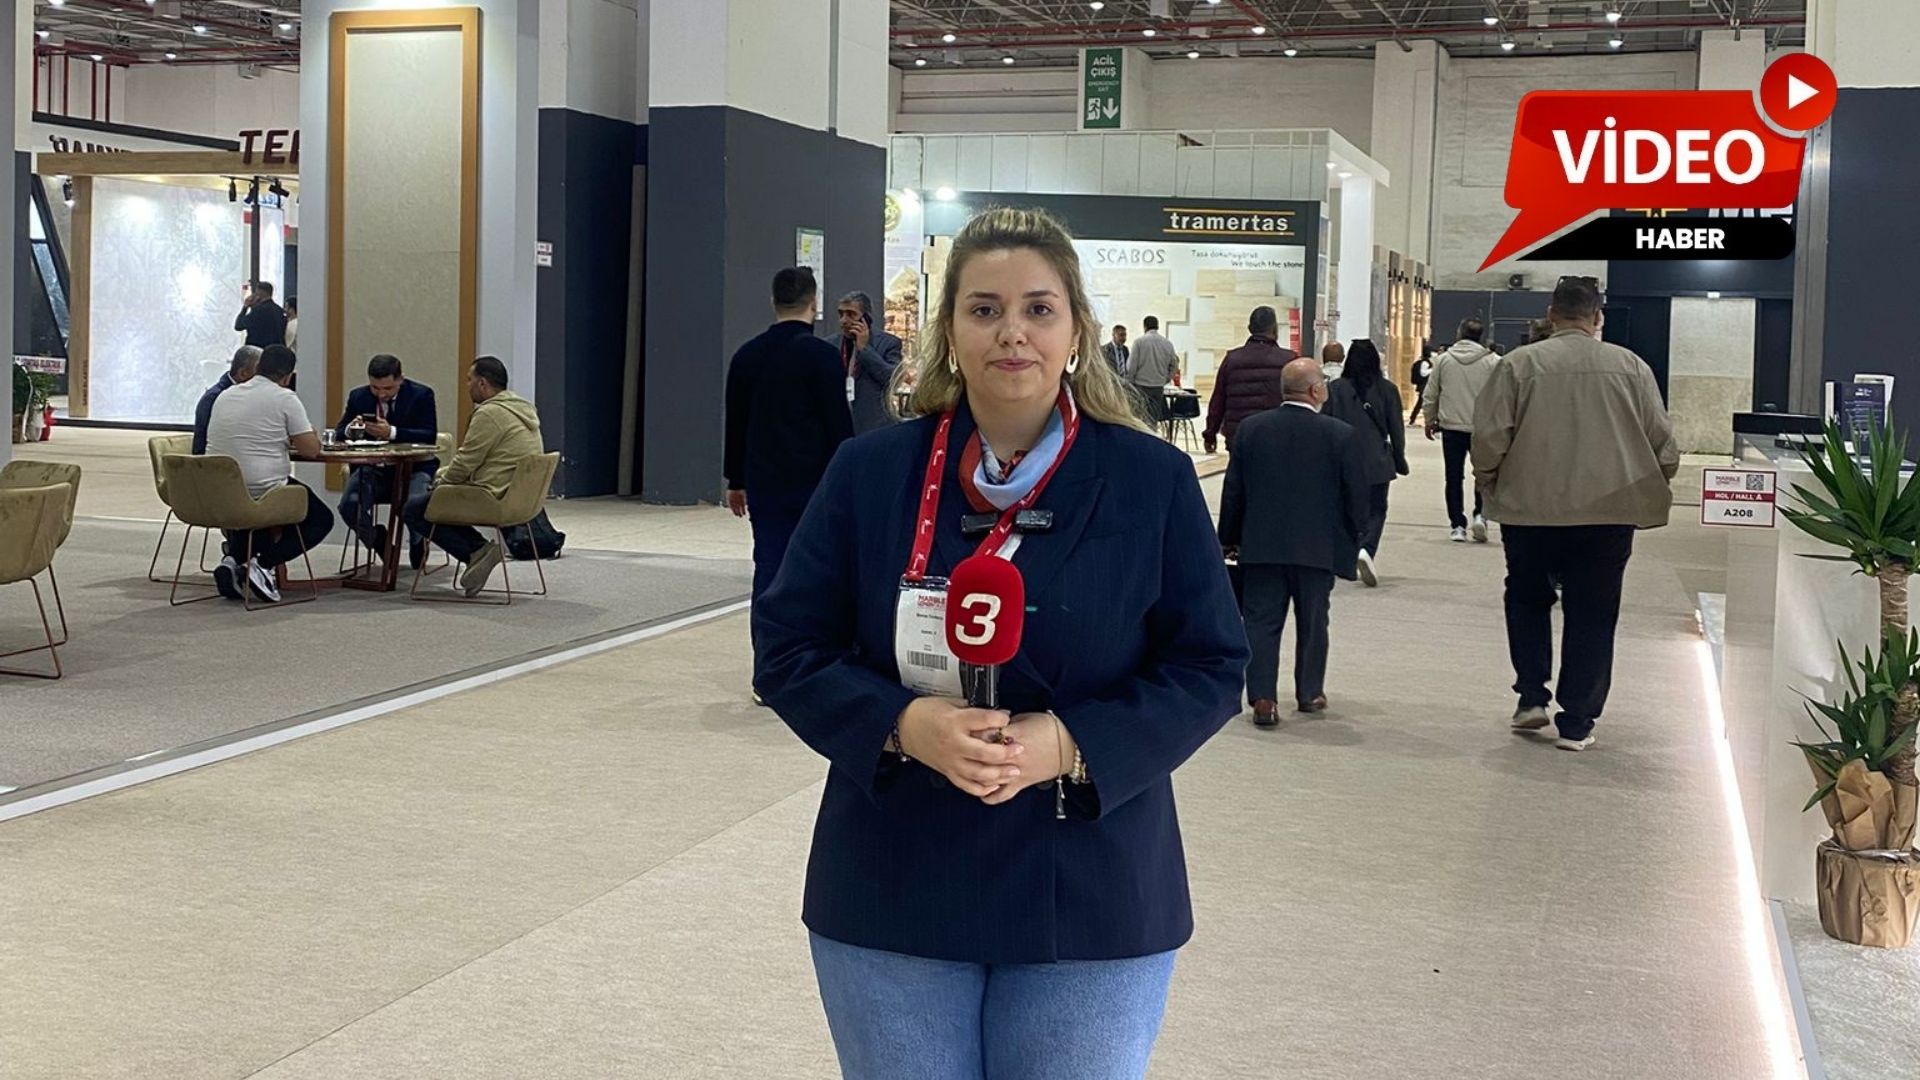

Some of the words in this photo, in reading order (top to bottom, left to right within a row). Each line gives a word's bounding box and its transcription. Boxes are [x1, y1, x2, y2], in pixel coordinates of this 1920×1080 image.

[1093, 54, 1115, 65] ACİL
[1090, 67, 1116, 78] ÇIKIŞ
[1097, 248, 1166, 264] SCABOS
[1268, 260, 1281, 268] the
[1723, 508, 1753, 518] A208
[955, 593, 1001, 645] 3
